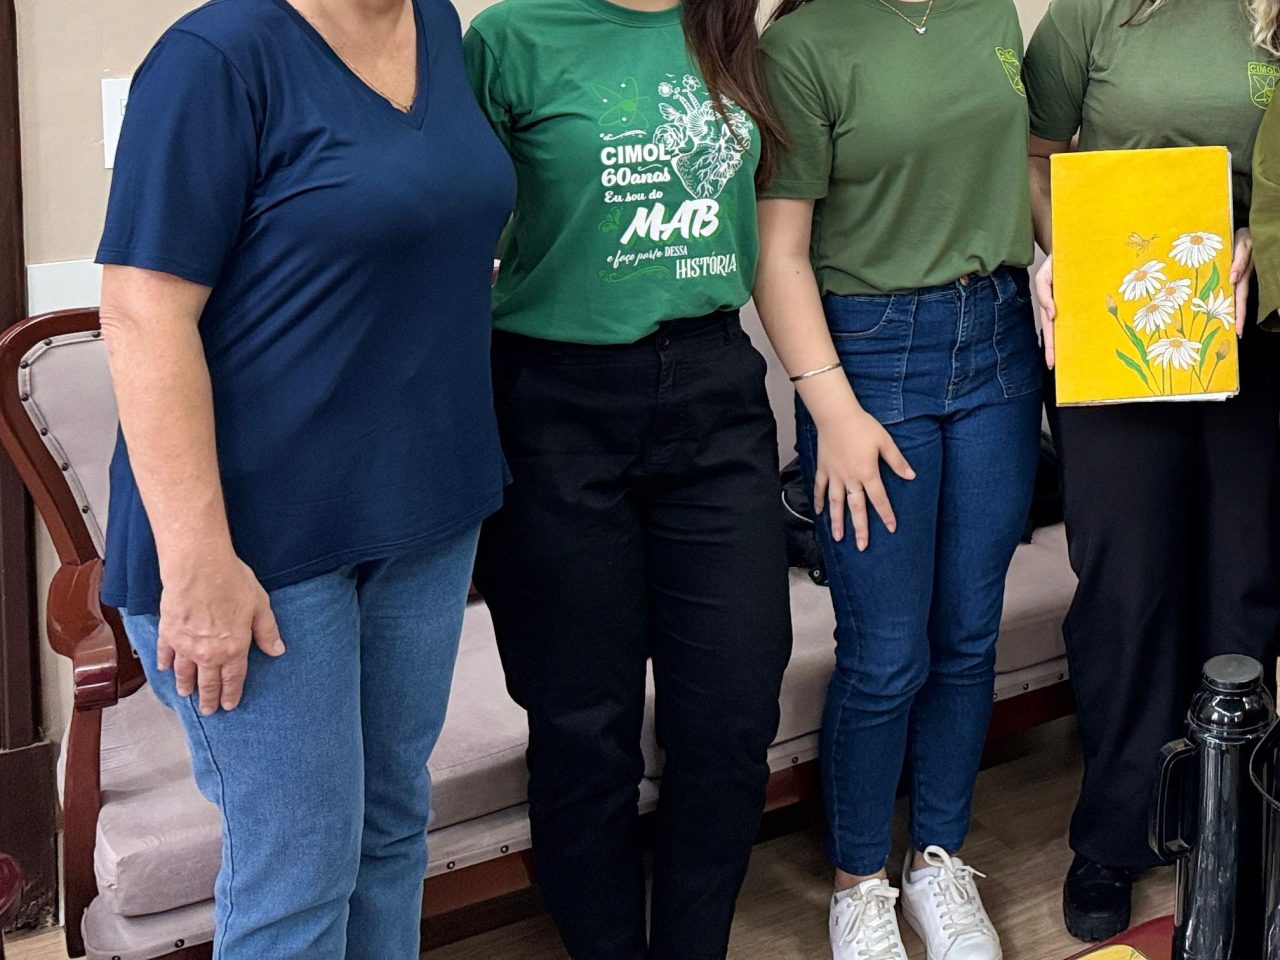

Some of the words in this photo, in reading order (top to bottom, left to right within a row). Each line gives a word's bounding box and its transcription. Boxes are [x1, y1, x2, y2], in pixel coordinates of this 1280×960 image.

[600, 143, 671, 166] CIMOL
[604, 190, 623, 204] Eu
[624, 191, 647, 203] sou
[648, 188, 663, 201] do
[619, 198, 720, 245] MAB
[633, 248, 663, 266] parte
[665, 245, 688, 257] DESSA
[676, 250, 737, 279] HISTÓRIA
